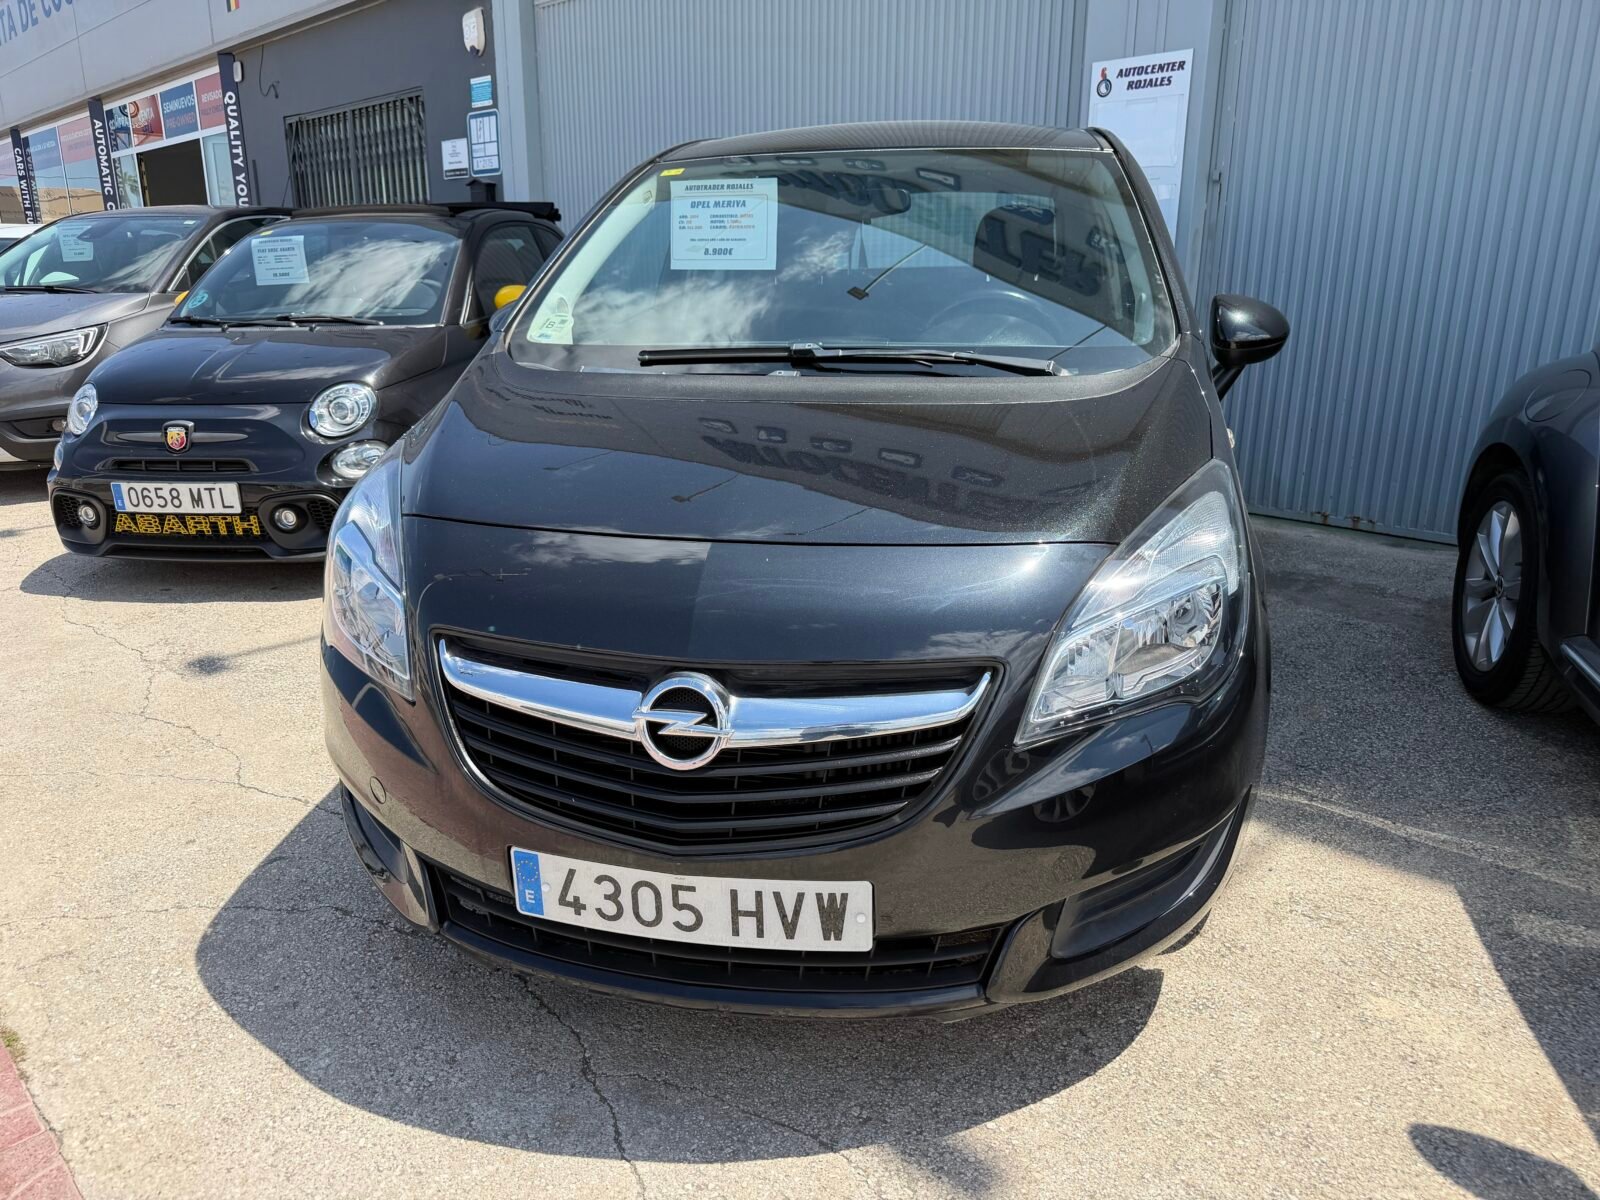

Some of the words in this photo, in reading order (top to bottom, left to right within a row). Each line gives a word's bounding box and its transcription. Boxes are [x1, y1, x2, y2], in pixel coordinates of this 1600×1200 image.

[0, 4, 17, 46] TA
[17, 0, 39, 33] DE
[1116, 60, 1186, 79] AUTOCENTER
[1126, 75, 1173, 91] ROJALES
[163, 94, 195, 113] SEMINUEVOS
[166, 112, 195, 129] PRE-OWNED
[223, 91, 244, 168] QUALITY
[93, 119, 114, 196] AUTOMATIC
[14, 148, 26, 176] CARS
[20, 180, 31, 208] WITH
[685, 184, 725, 192] AUTOTRADER
[690, 201, 711, 209] OPEL
[713, 200, 747, 208] MERIVA
[703, 247, 734, 256] 8.900€
[127, 486, 183, 509] 0658
[188, 487, 235, 509] MTL
[115, 513, 261, 536] ABARTH
[525, 890, 535, 904] E
[557, 868, 704, 932] 4305
[729, 888, 849, 941] HVW
